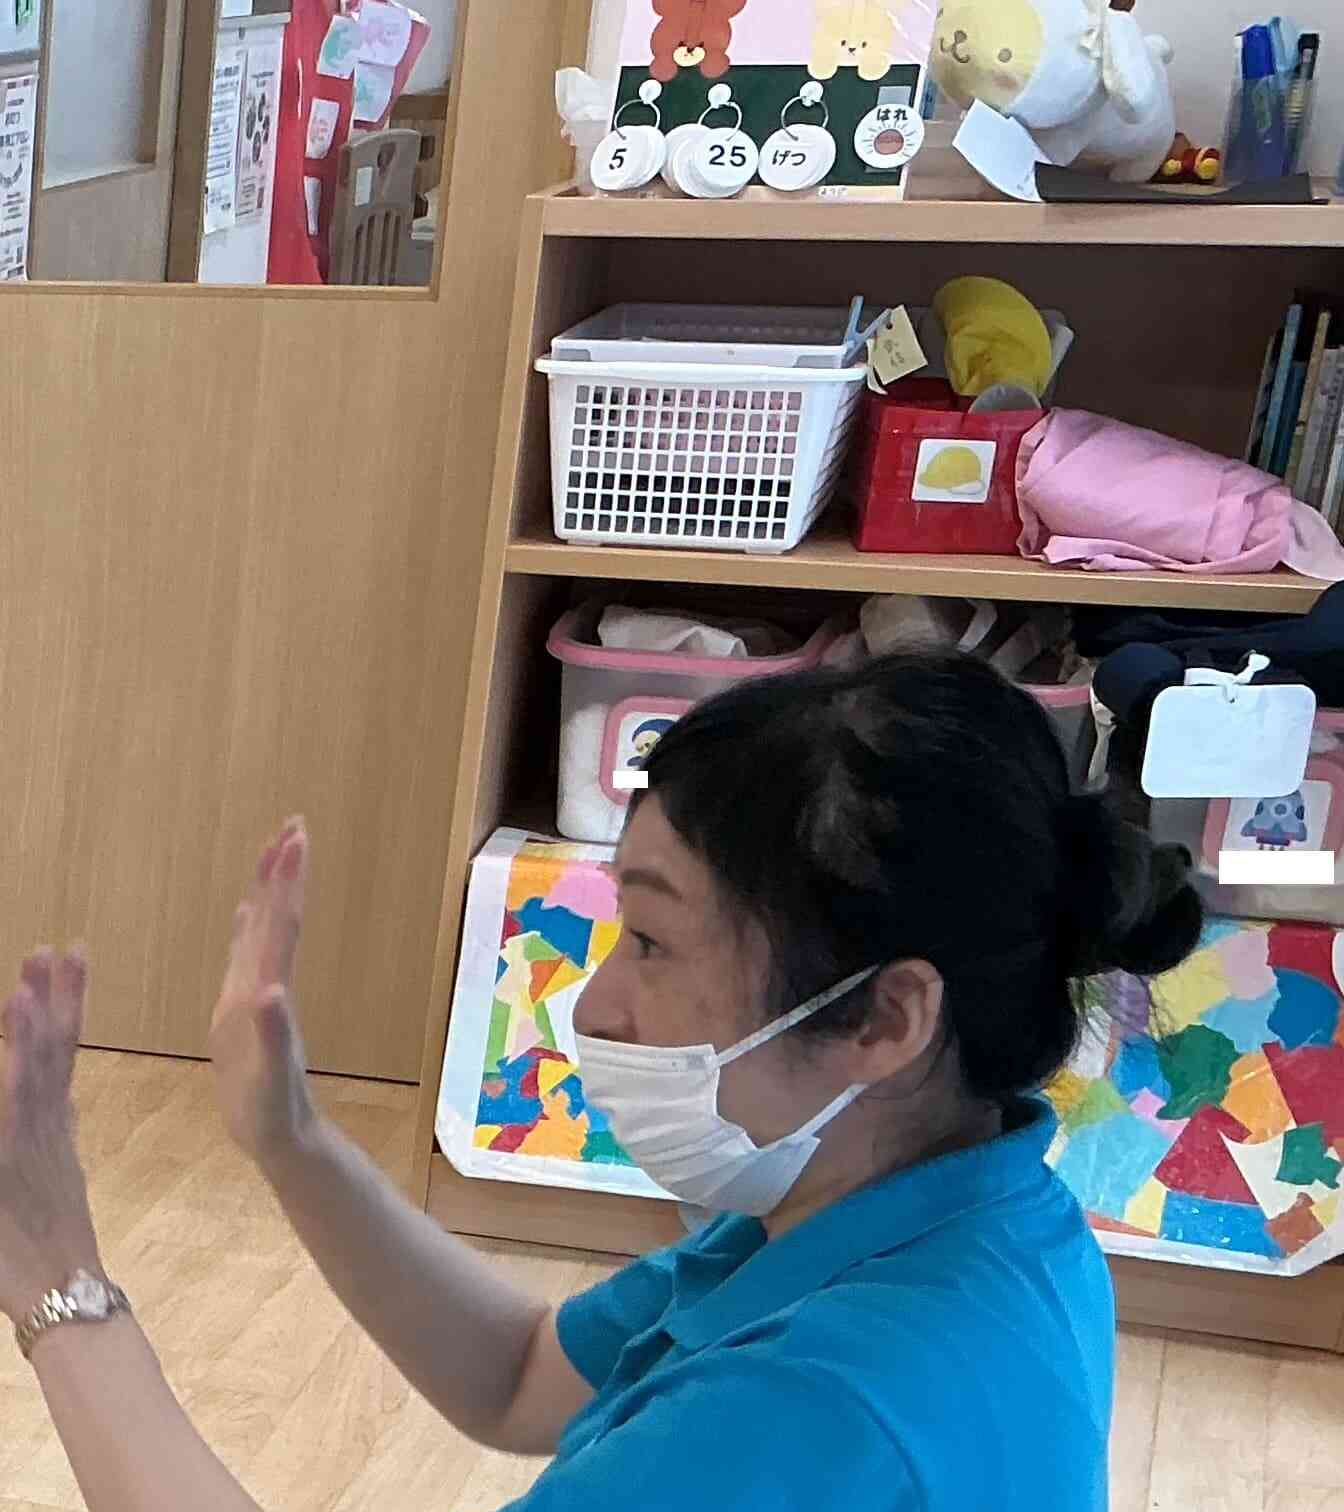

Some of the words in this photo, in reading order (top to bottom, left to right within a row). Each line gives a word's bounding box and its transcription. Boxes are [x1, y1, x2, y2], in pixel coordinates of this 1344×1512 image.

[877, 108, 908, 120] はれ
[609, 148, 627, 170] 5
[709, 145, 746, 167] 25
[772, 149, 806, 166] げつ
